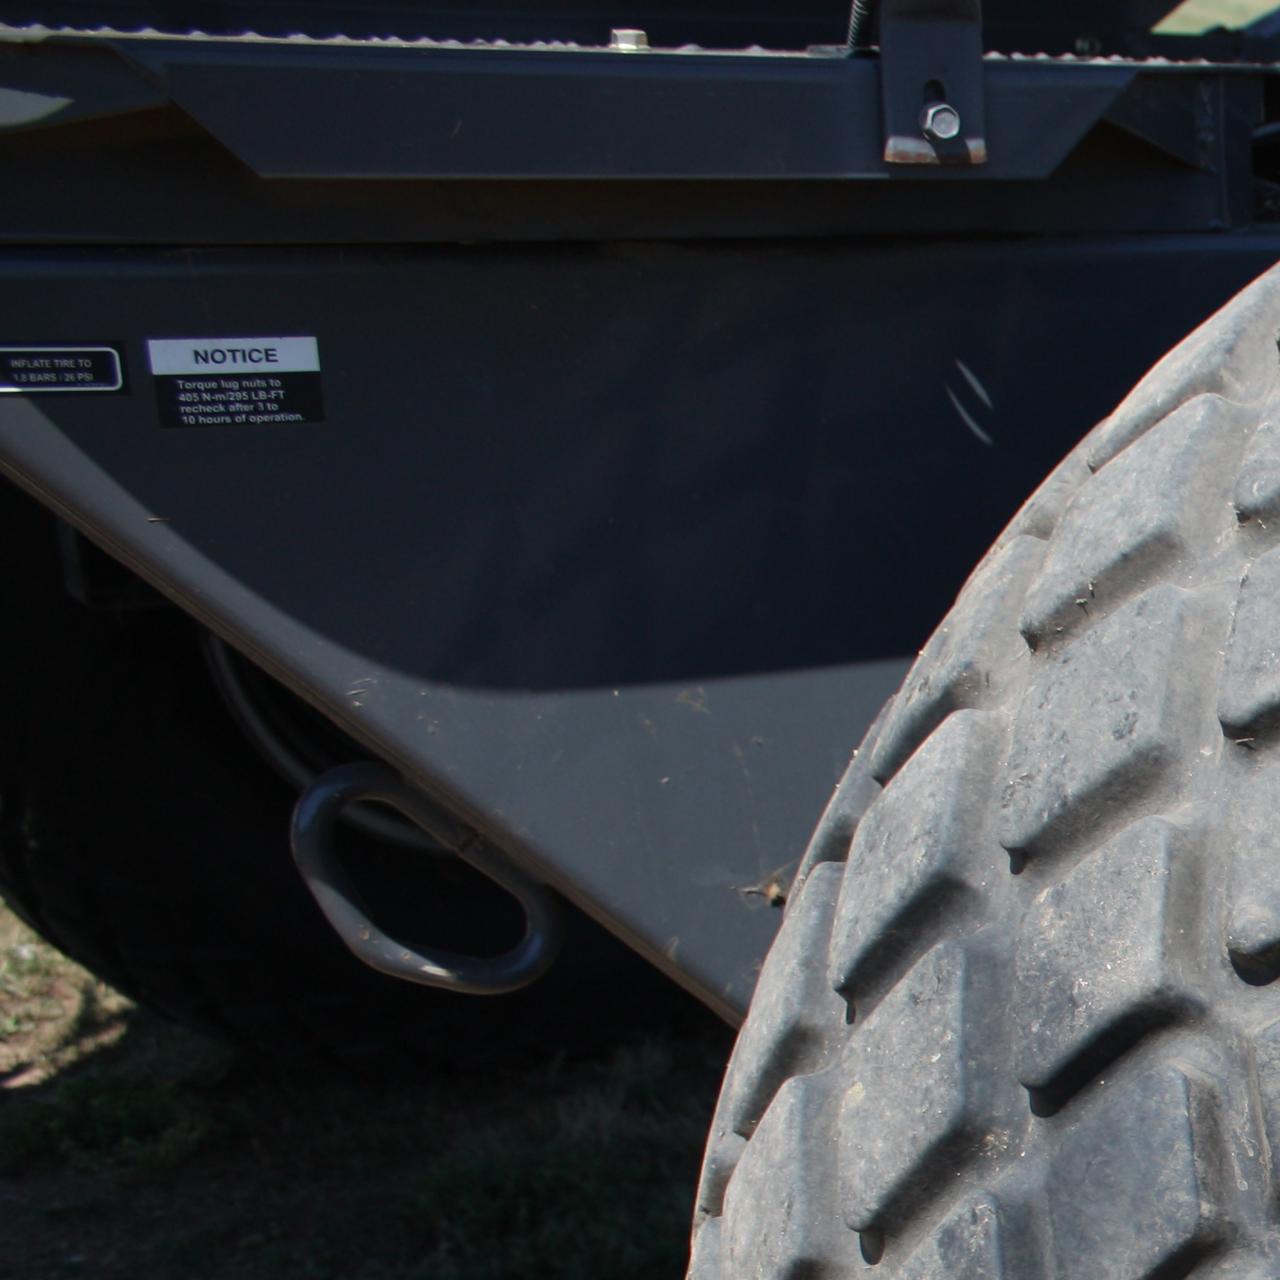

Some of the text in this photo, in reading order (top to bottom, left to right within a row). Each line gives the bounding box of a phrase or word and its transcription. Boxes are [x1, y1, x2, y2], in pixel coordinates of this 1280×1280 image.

[194, 348, 279, 364] NOTICE
[11, 359, 92, 368] INFLATE TIRE TO
[29, 373, 57, 382] BARS
[64, 373, 75, 382] 26
[77, 372, 94, 382] PSI
[177, 379, 282, 390] Torque lug nuts to
[178, 393, 199, 402] 405
[252, 390, 285, 400] LB-FT
[180, 402, 279, 413] recheck after 3 to
[183, 416, 196, 425] 10
[199, 415, 232, 424] hours
[235, 415, 246, 423] of
